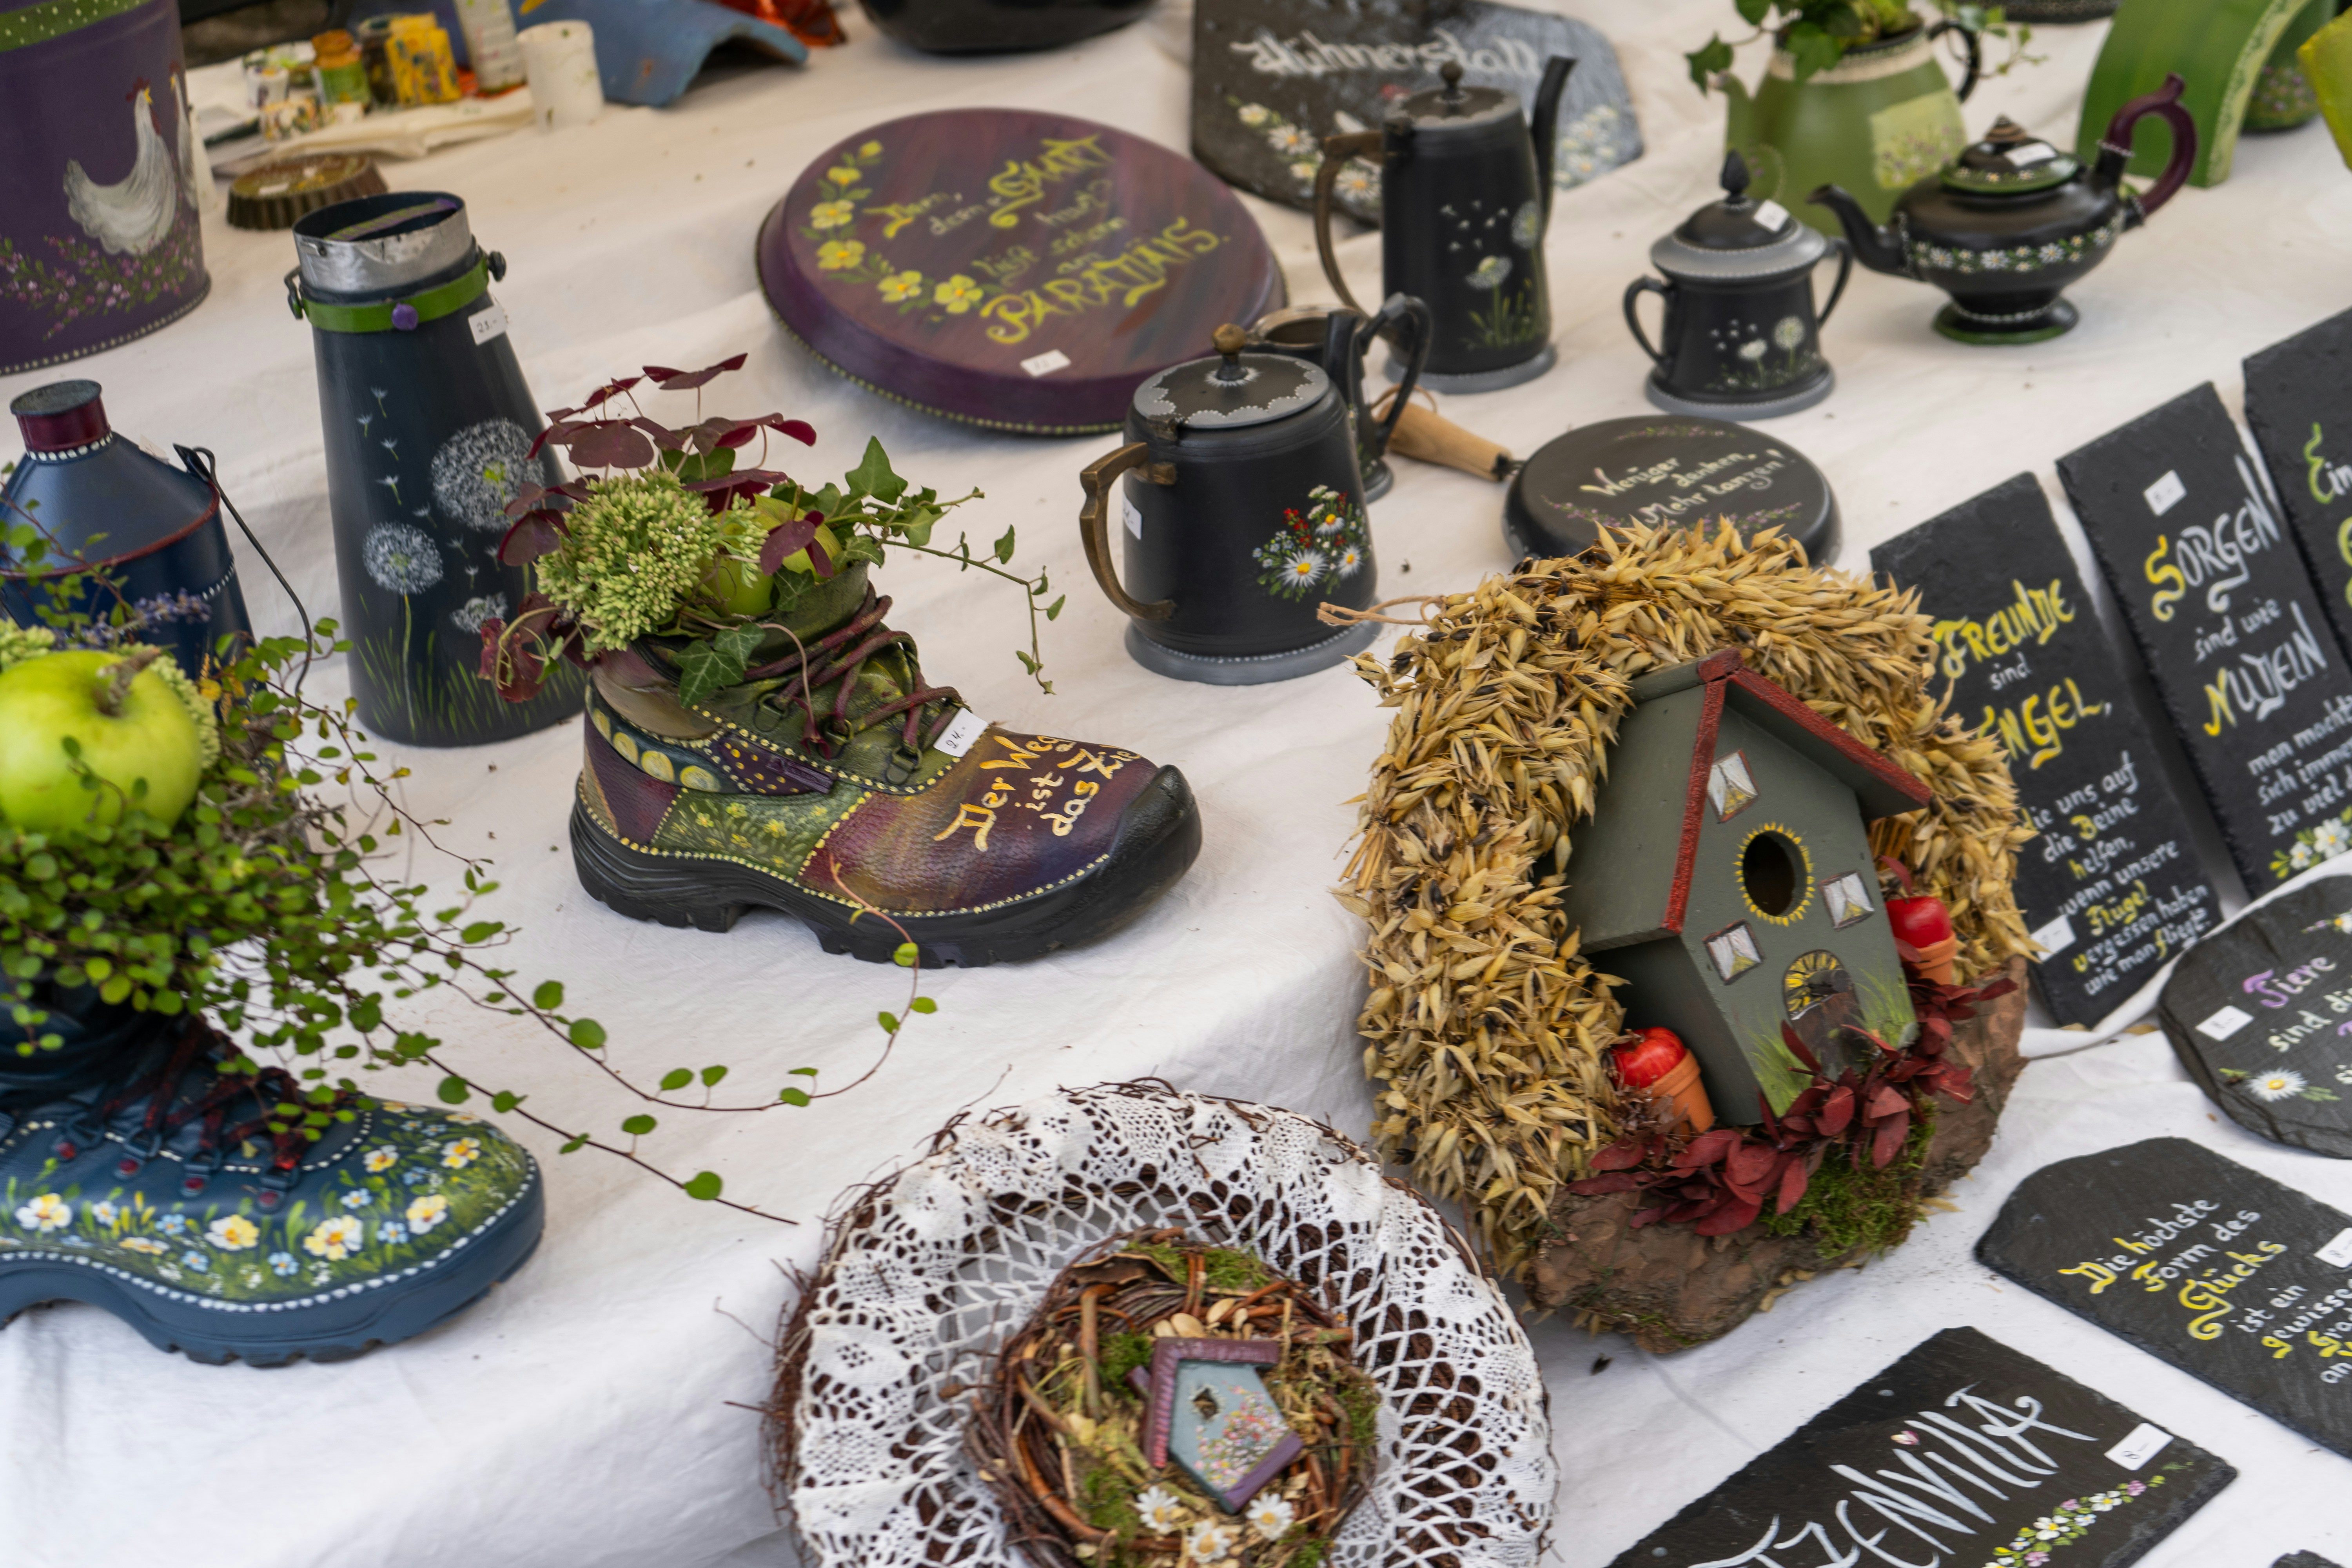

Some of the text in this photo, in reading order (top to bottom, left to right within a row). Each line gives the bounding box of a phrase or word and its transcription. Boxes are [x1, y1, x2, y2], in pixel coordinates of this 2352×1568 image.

[1580, 456, 1682, 496] Weniger
[1638, 492, 1710, 524] Mehr
[2143, 453, 2282, 622] SORGEN
[1933, 578, 2077, 679] FREUNDE
[2195, 596, 2283, 662] sind wie
[1990, 651, 2033, 691] sind
[2203, 599, 2328, 737] NUDELN
[933, 735, 1077, 853] Der Weg
[1013, 770, 1065, 812] ist
[1039, 780, 1100, 837] das
[2054, 782, 2099, 815] uns
[2100, 749, 2139, 794] auf
[2257, 767, 2299, 807] sich
[2266, 807, 2301, 837] zu
[2300, 771, 2347, 815] viel
[2043, 796, 2140, 863] die Beine
[2057, 839, 2180, 916] wenn unsere
[2072, 884, 2210, 973] vergessen haben
[2083, 965, 2120, 996] wie
[2242, 955, 2338, 1009] Tiere
[2267, 1008, 2335, 1053] sind
[2057, 1199, 2221, 1295] Die höchste
[2130, 1209, 2263, 1292] Form des
[2178, 1239, 2288, 1341] Glücks
[2228, 1284, 2308, 1333] ist ein
